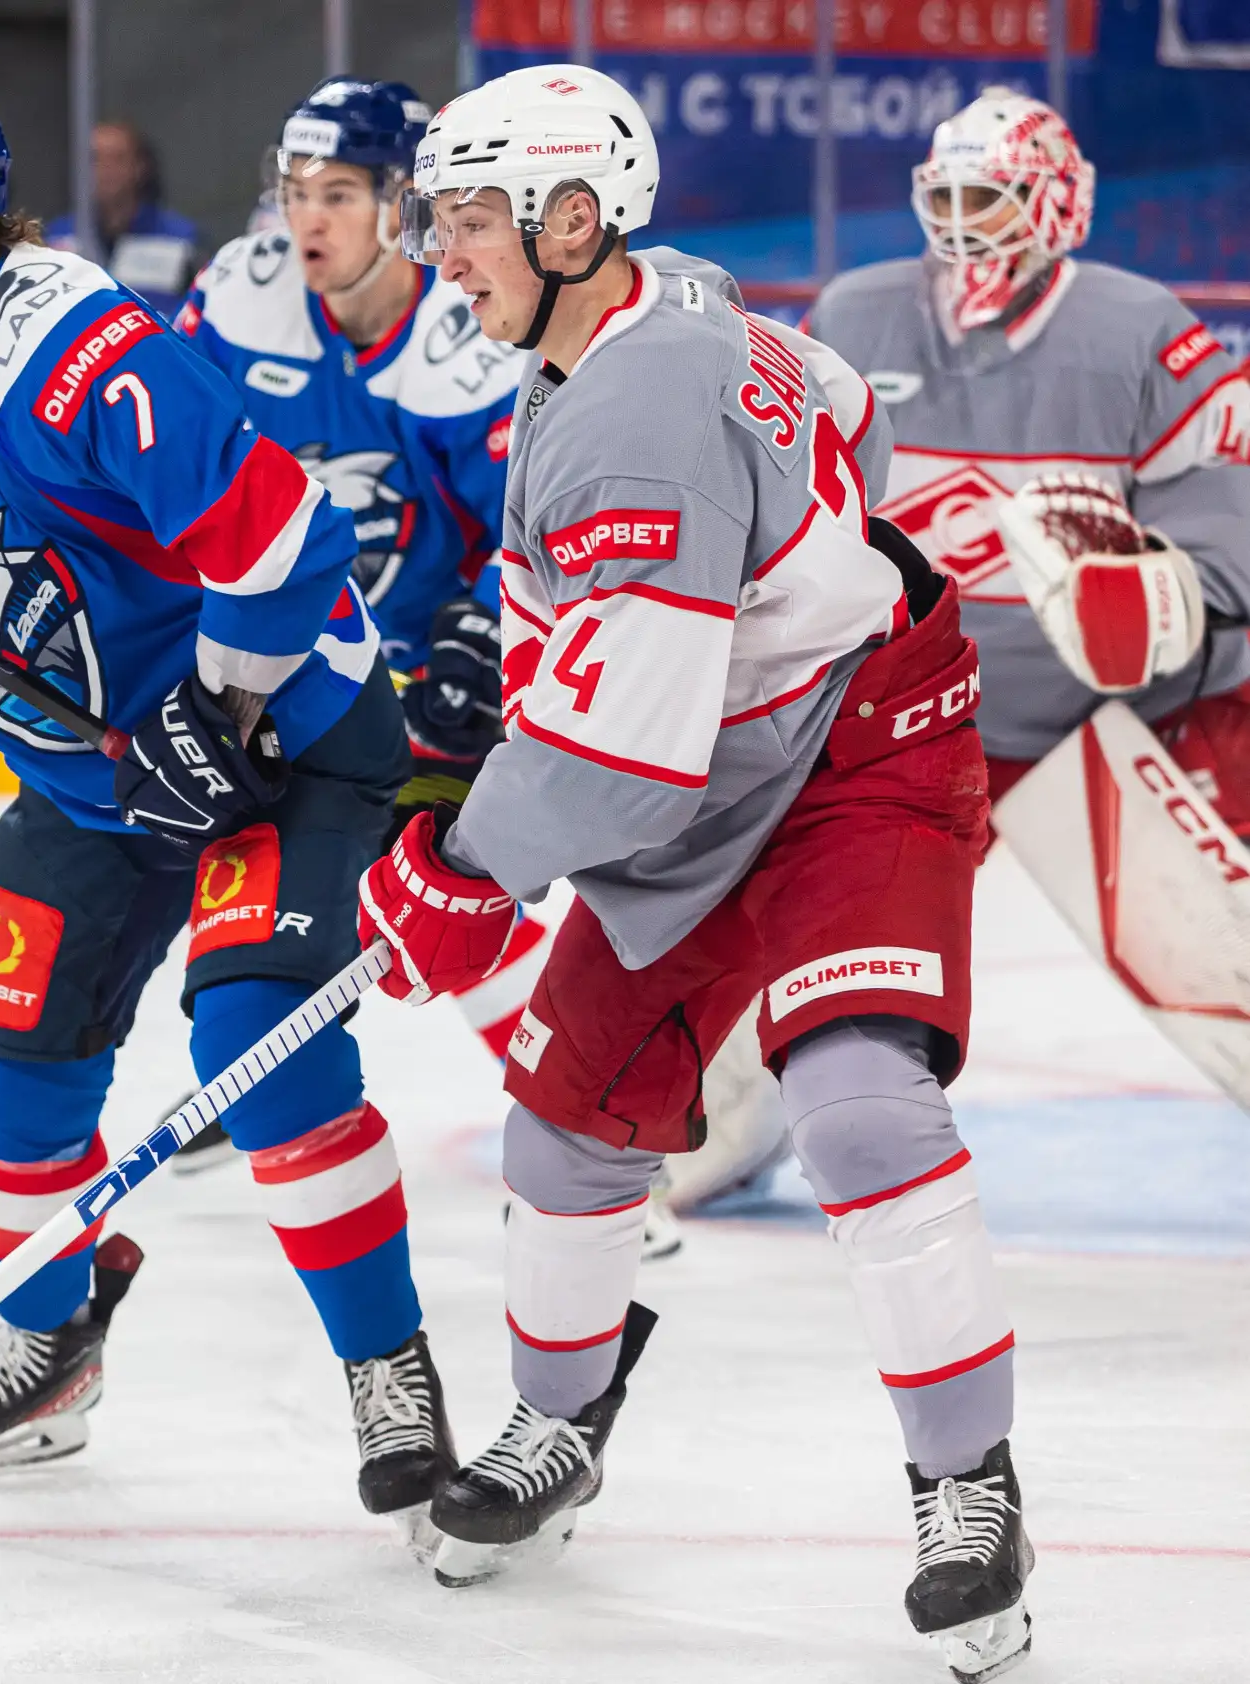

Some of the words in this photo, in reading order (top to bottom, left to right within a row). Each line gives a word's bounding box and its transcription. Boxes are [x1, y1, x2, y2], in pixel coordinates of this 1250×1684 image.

[526, 144, 602, 155] OLIMPBET
[44, 309, 151, 423] OLIMPBET
[104, 371, 155, 454] 7
[551, 523, 675, 566] OLIPBET
[891, 664, 981, 740] CCM
[1133, 753, 1250, 883] CCM
[191, 905, 268, 938] LIMPBET
[785, 961, 922, 997] OLIMPBET
[965, 1641, 981, 1656] CCM
